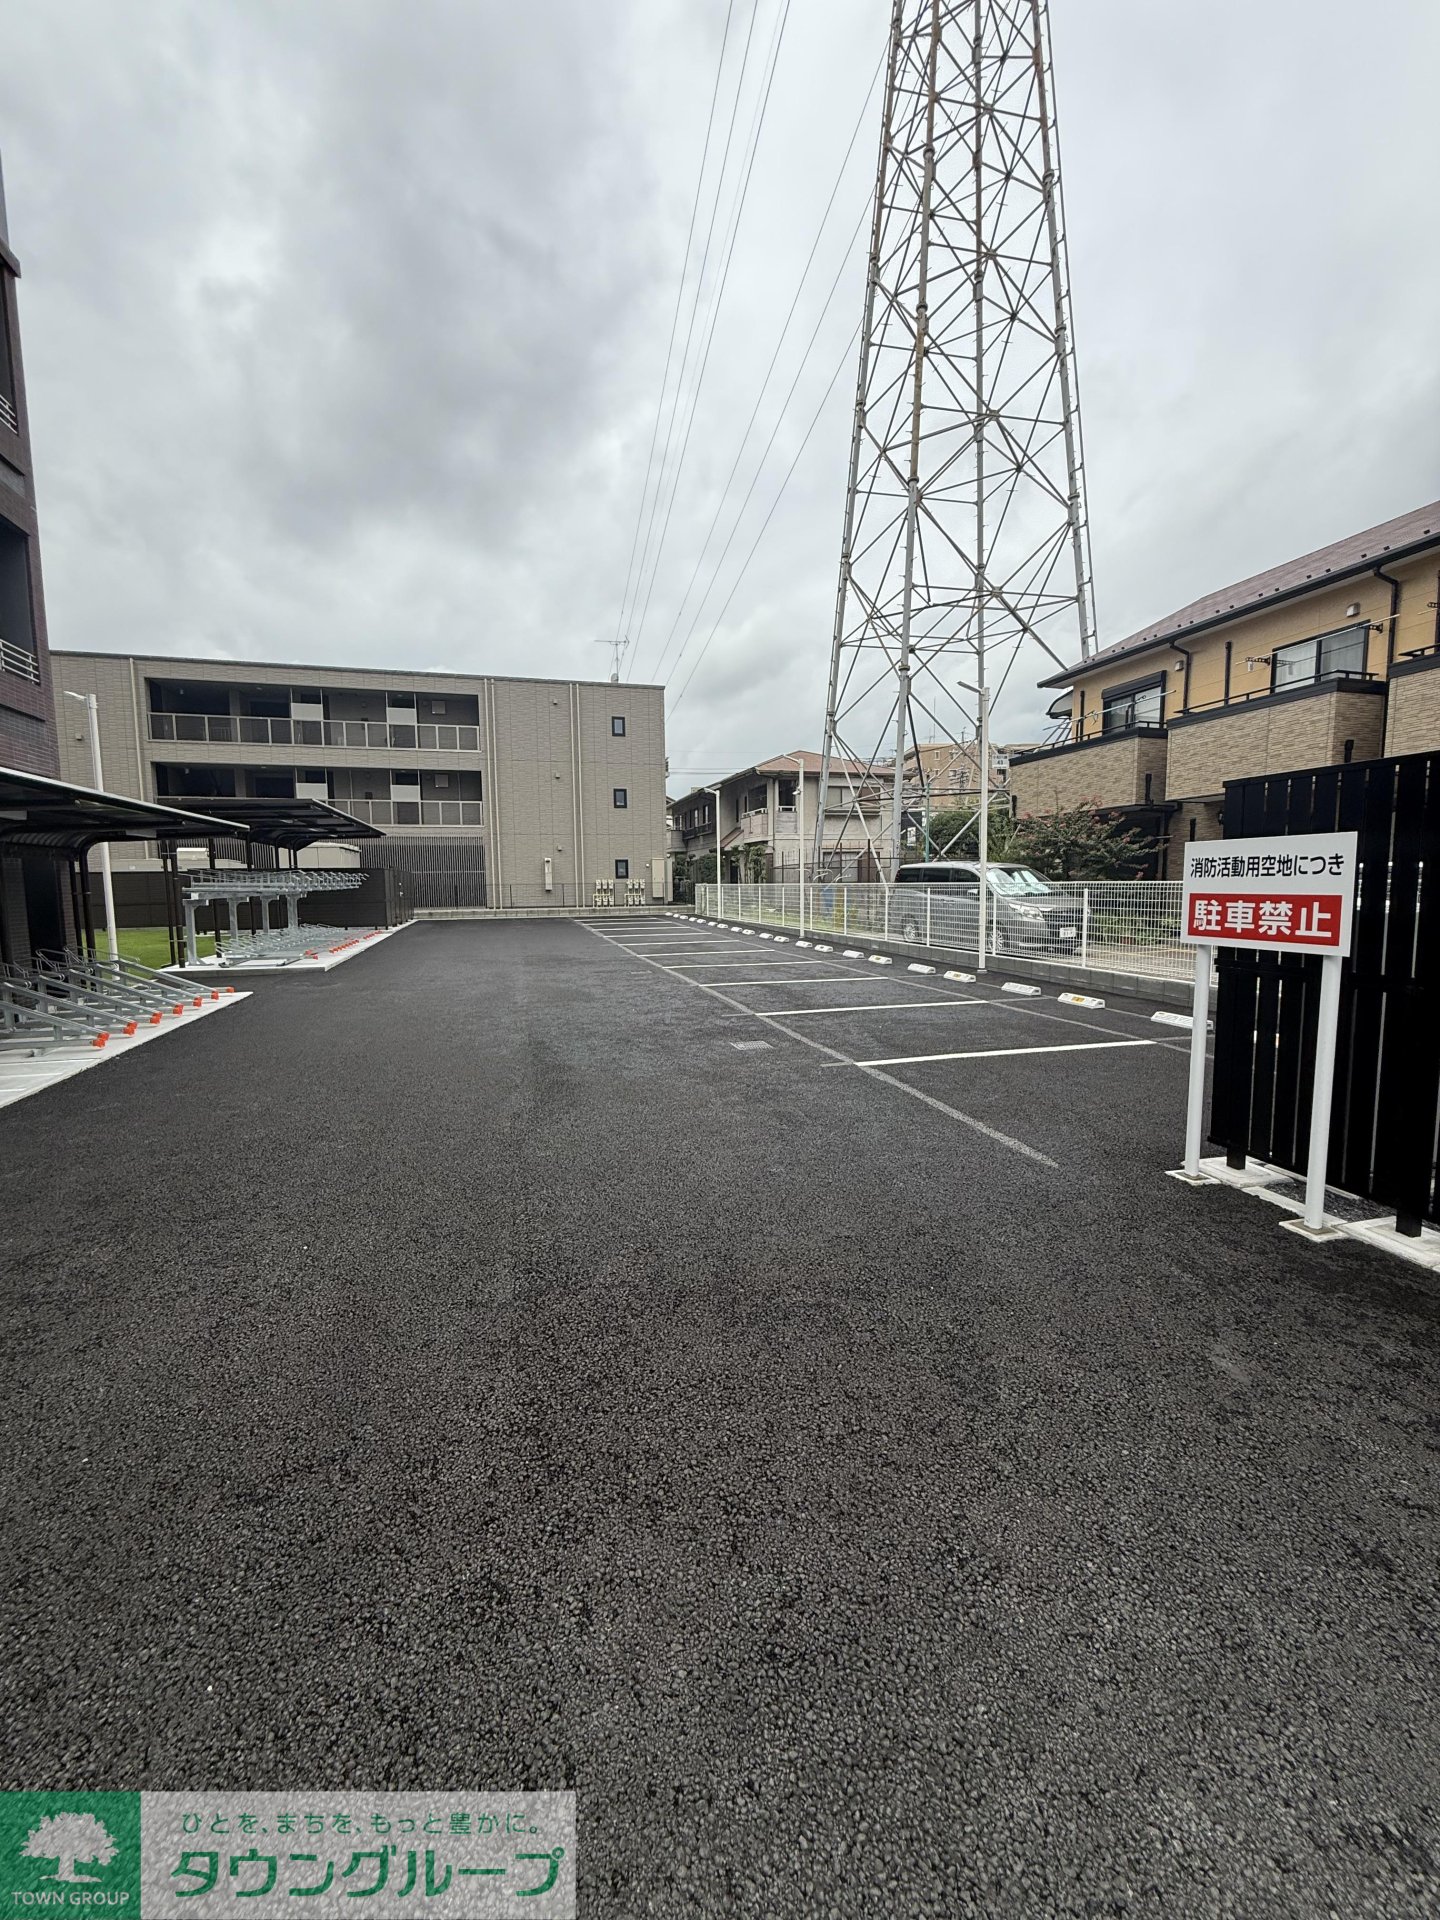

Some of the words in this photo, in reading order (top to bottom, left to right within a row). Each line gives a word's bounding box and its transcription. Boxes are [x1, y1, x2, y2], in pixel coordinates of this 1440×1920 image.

[1190, 853, 1344, 878] 消防活動用空地につき
[1193, 899, 1332, 938] 駐車禁止
